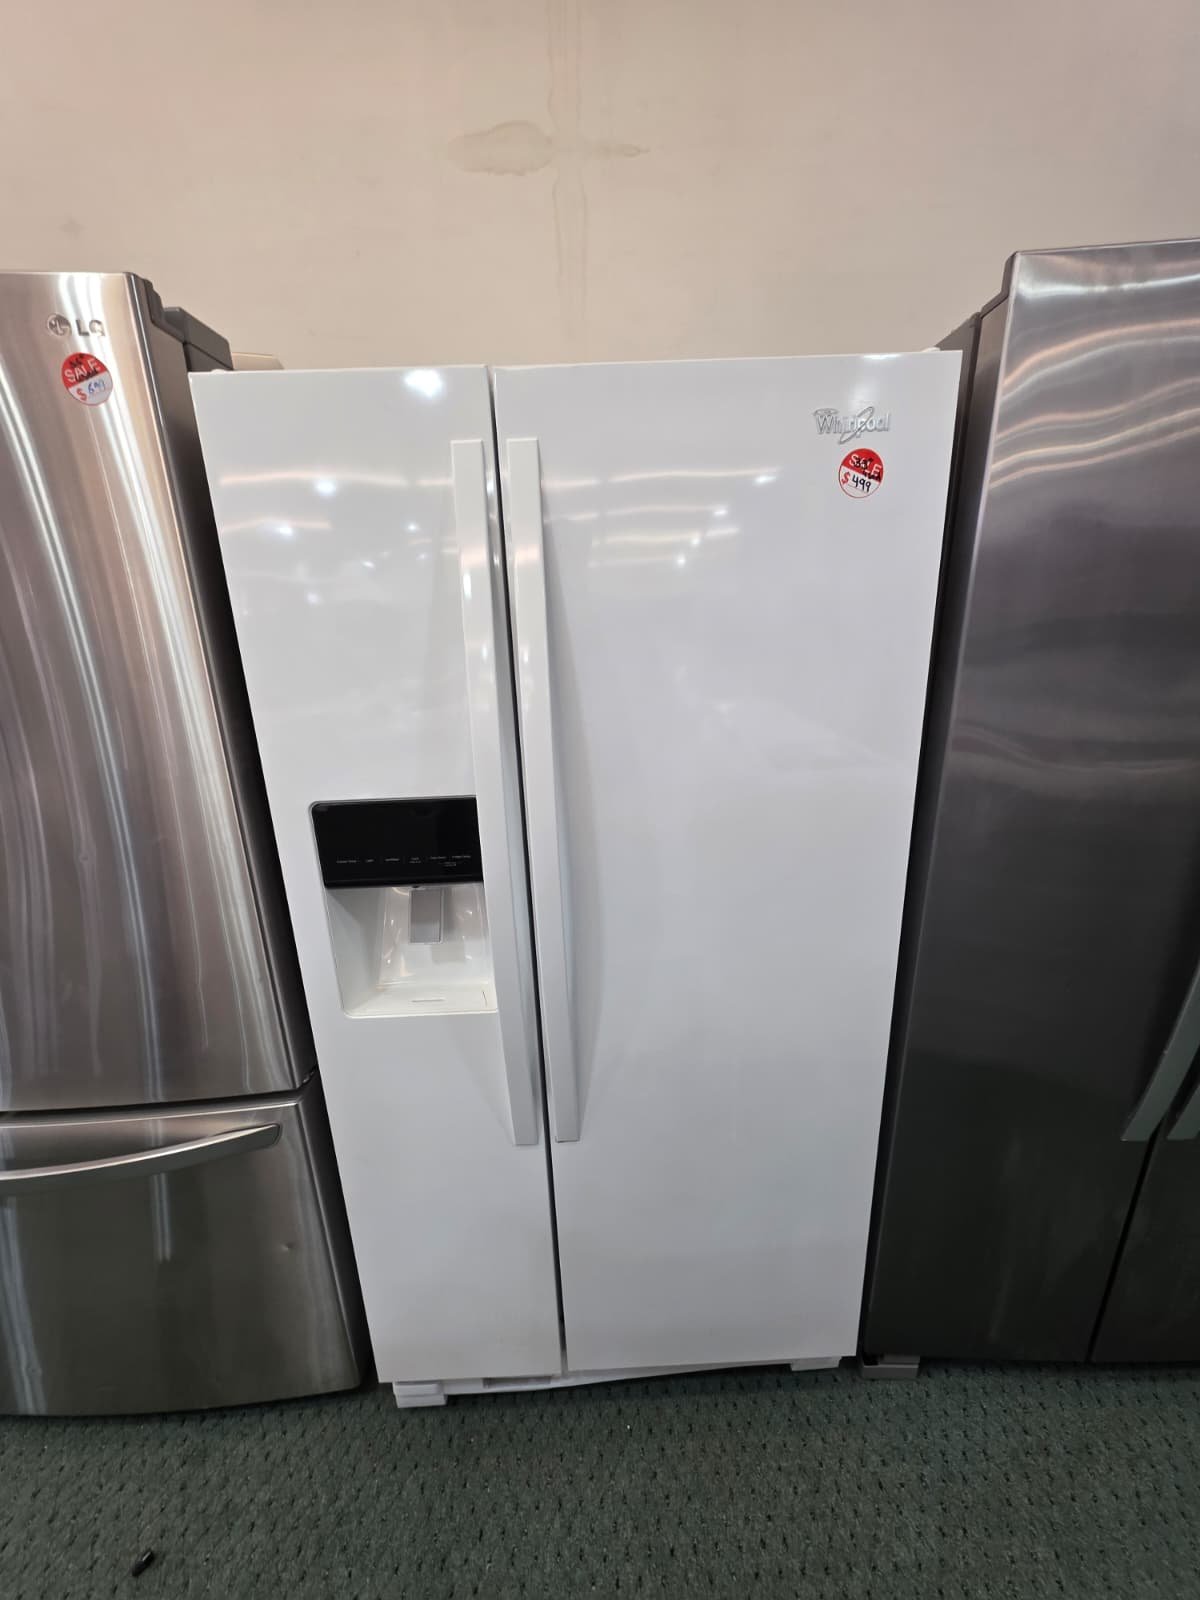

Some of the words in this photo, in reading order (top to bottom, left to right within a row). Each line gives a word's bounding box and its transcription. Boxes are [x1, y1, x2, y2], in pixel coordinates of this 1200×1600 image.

[75, 320, 105, 337] LG
[64, 359, 100, 383] SALE
[813, 406, 891, 444] Whirlpool
